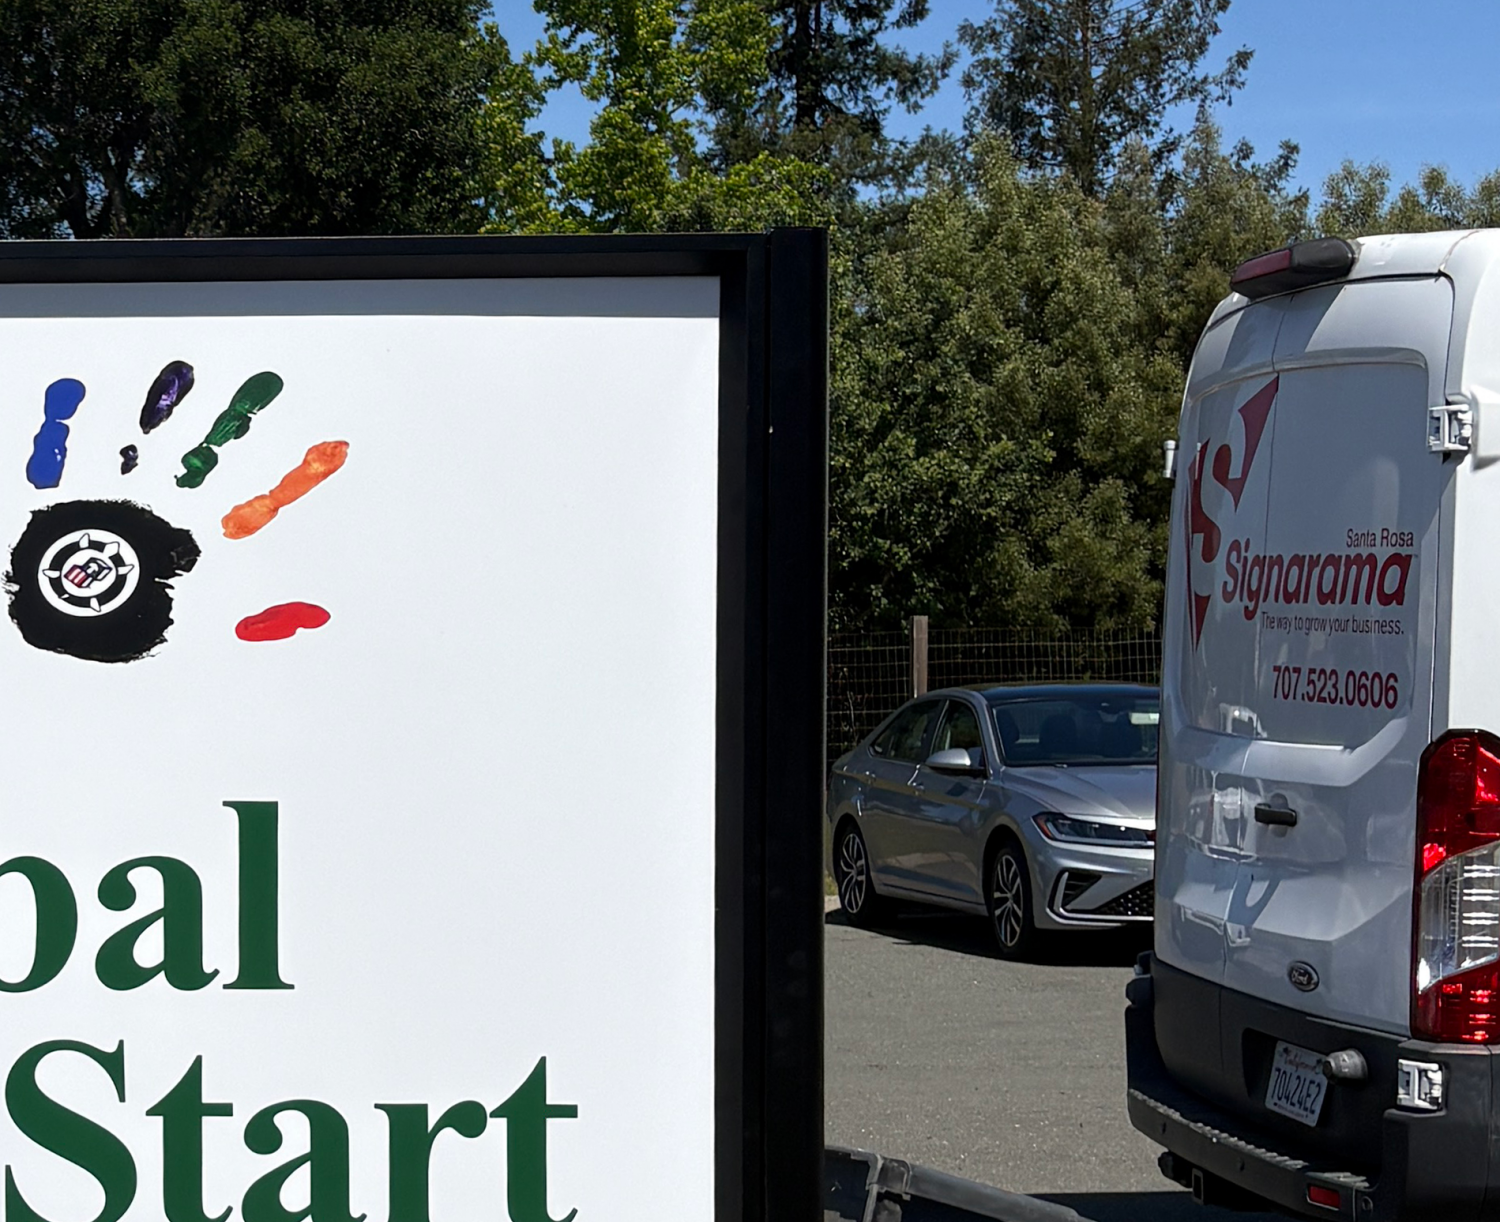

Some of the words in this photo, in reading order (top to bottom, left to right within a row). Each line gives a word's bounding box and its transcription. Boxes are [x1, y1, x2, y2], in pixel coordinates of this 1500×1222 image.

[1346, 527, 1376, 549] Santa
[1380, 527, 1414, 548] Rosa
[1221, 539, 1414, 621] Signarama
[1261, 611, 1275, 630] The
[1276, 616, 1292, 635] way
[1294, 615, 1303, 631] to
[1304, 617, 1327, 636] grow
[1328, 618, 1350, 637] your
[1351, 614, 1405, 635] business.
[1273, 665, 1399, 710] 707.523.0606
